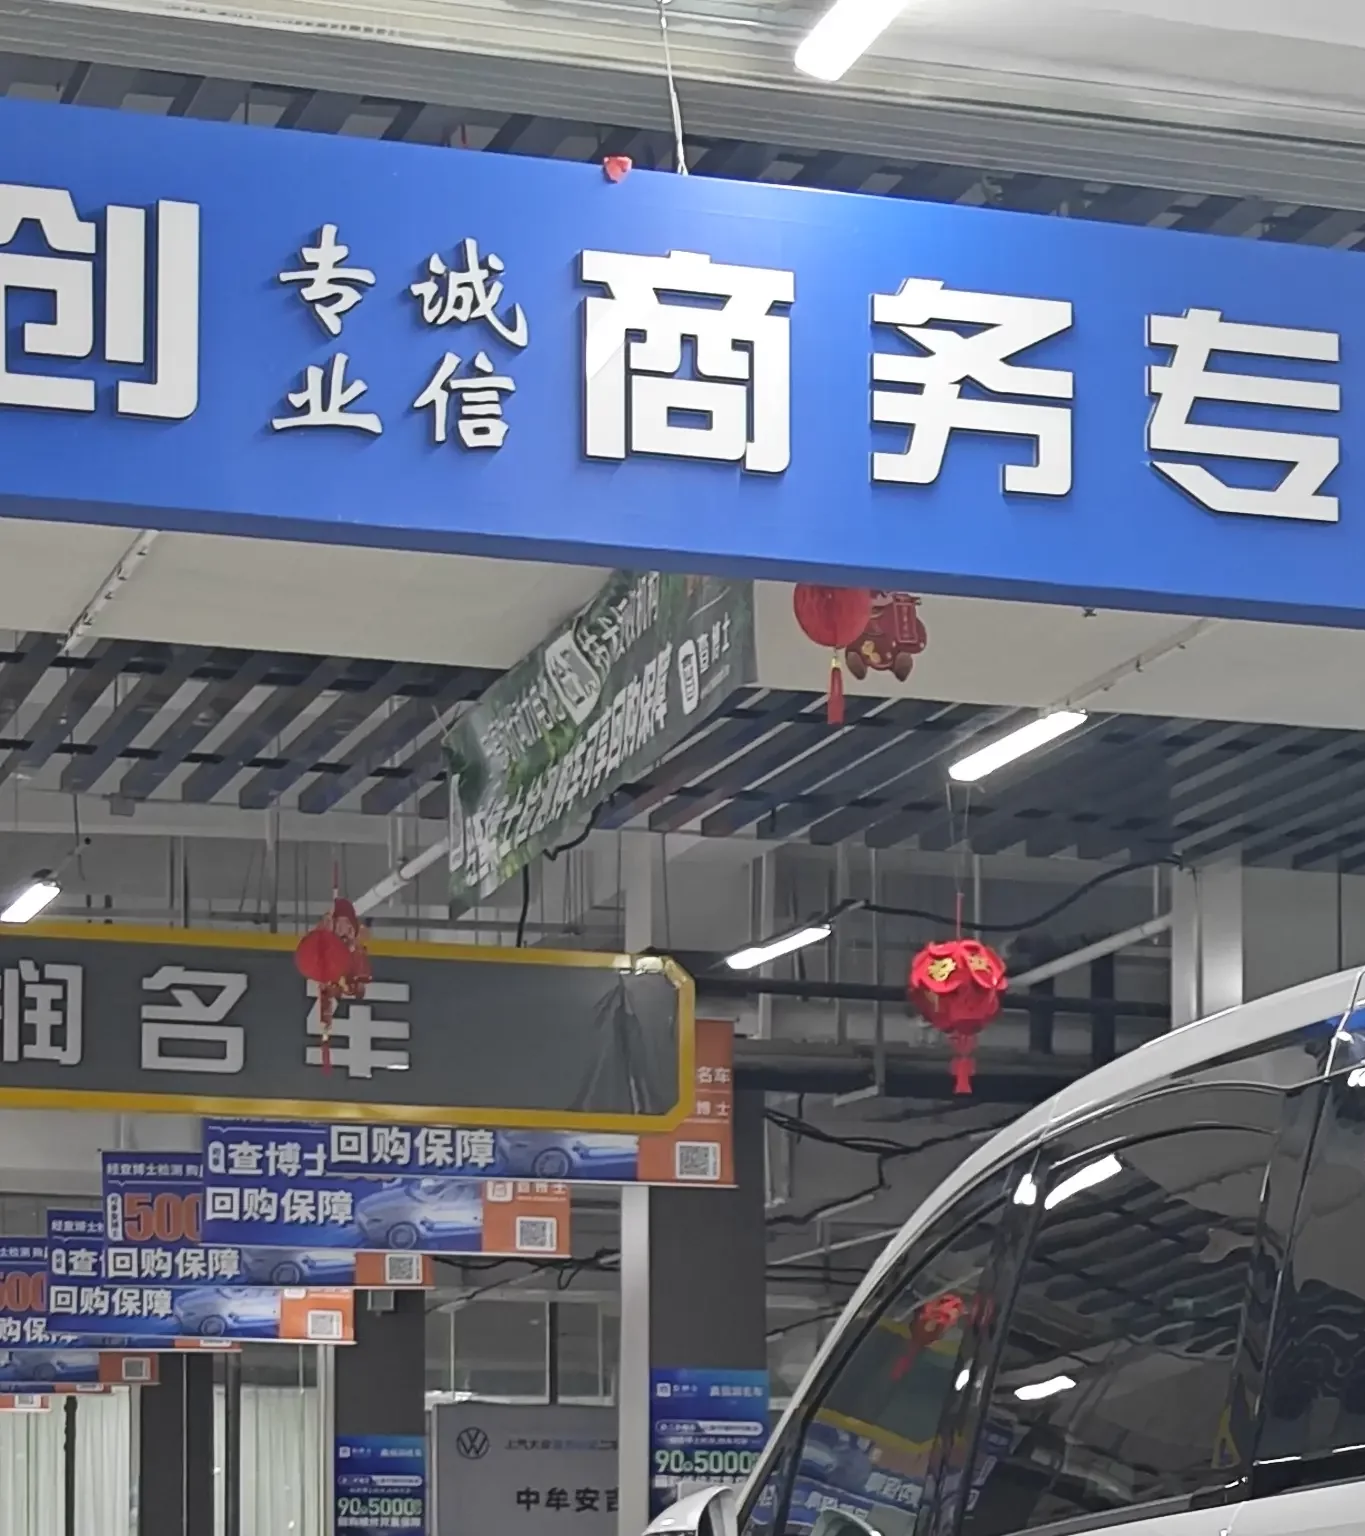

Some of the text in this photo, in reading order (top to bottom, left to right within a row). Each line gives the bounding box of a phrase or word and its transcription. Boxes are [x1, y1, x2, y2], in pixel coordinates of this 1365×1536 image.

[0, 183, 200, 420] 创
[329, 1124, 496, 1169] 回购保障
[205, 1186, 355, 1226] 回购保障
[107, 1247, 242, 1281] 回购保障
[49, 1285, 174, 1319] 回购保障
